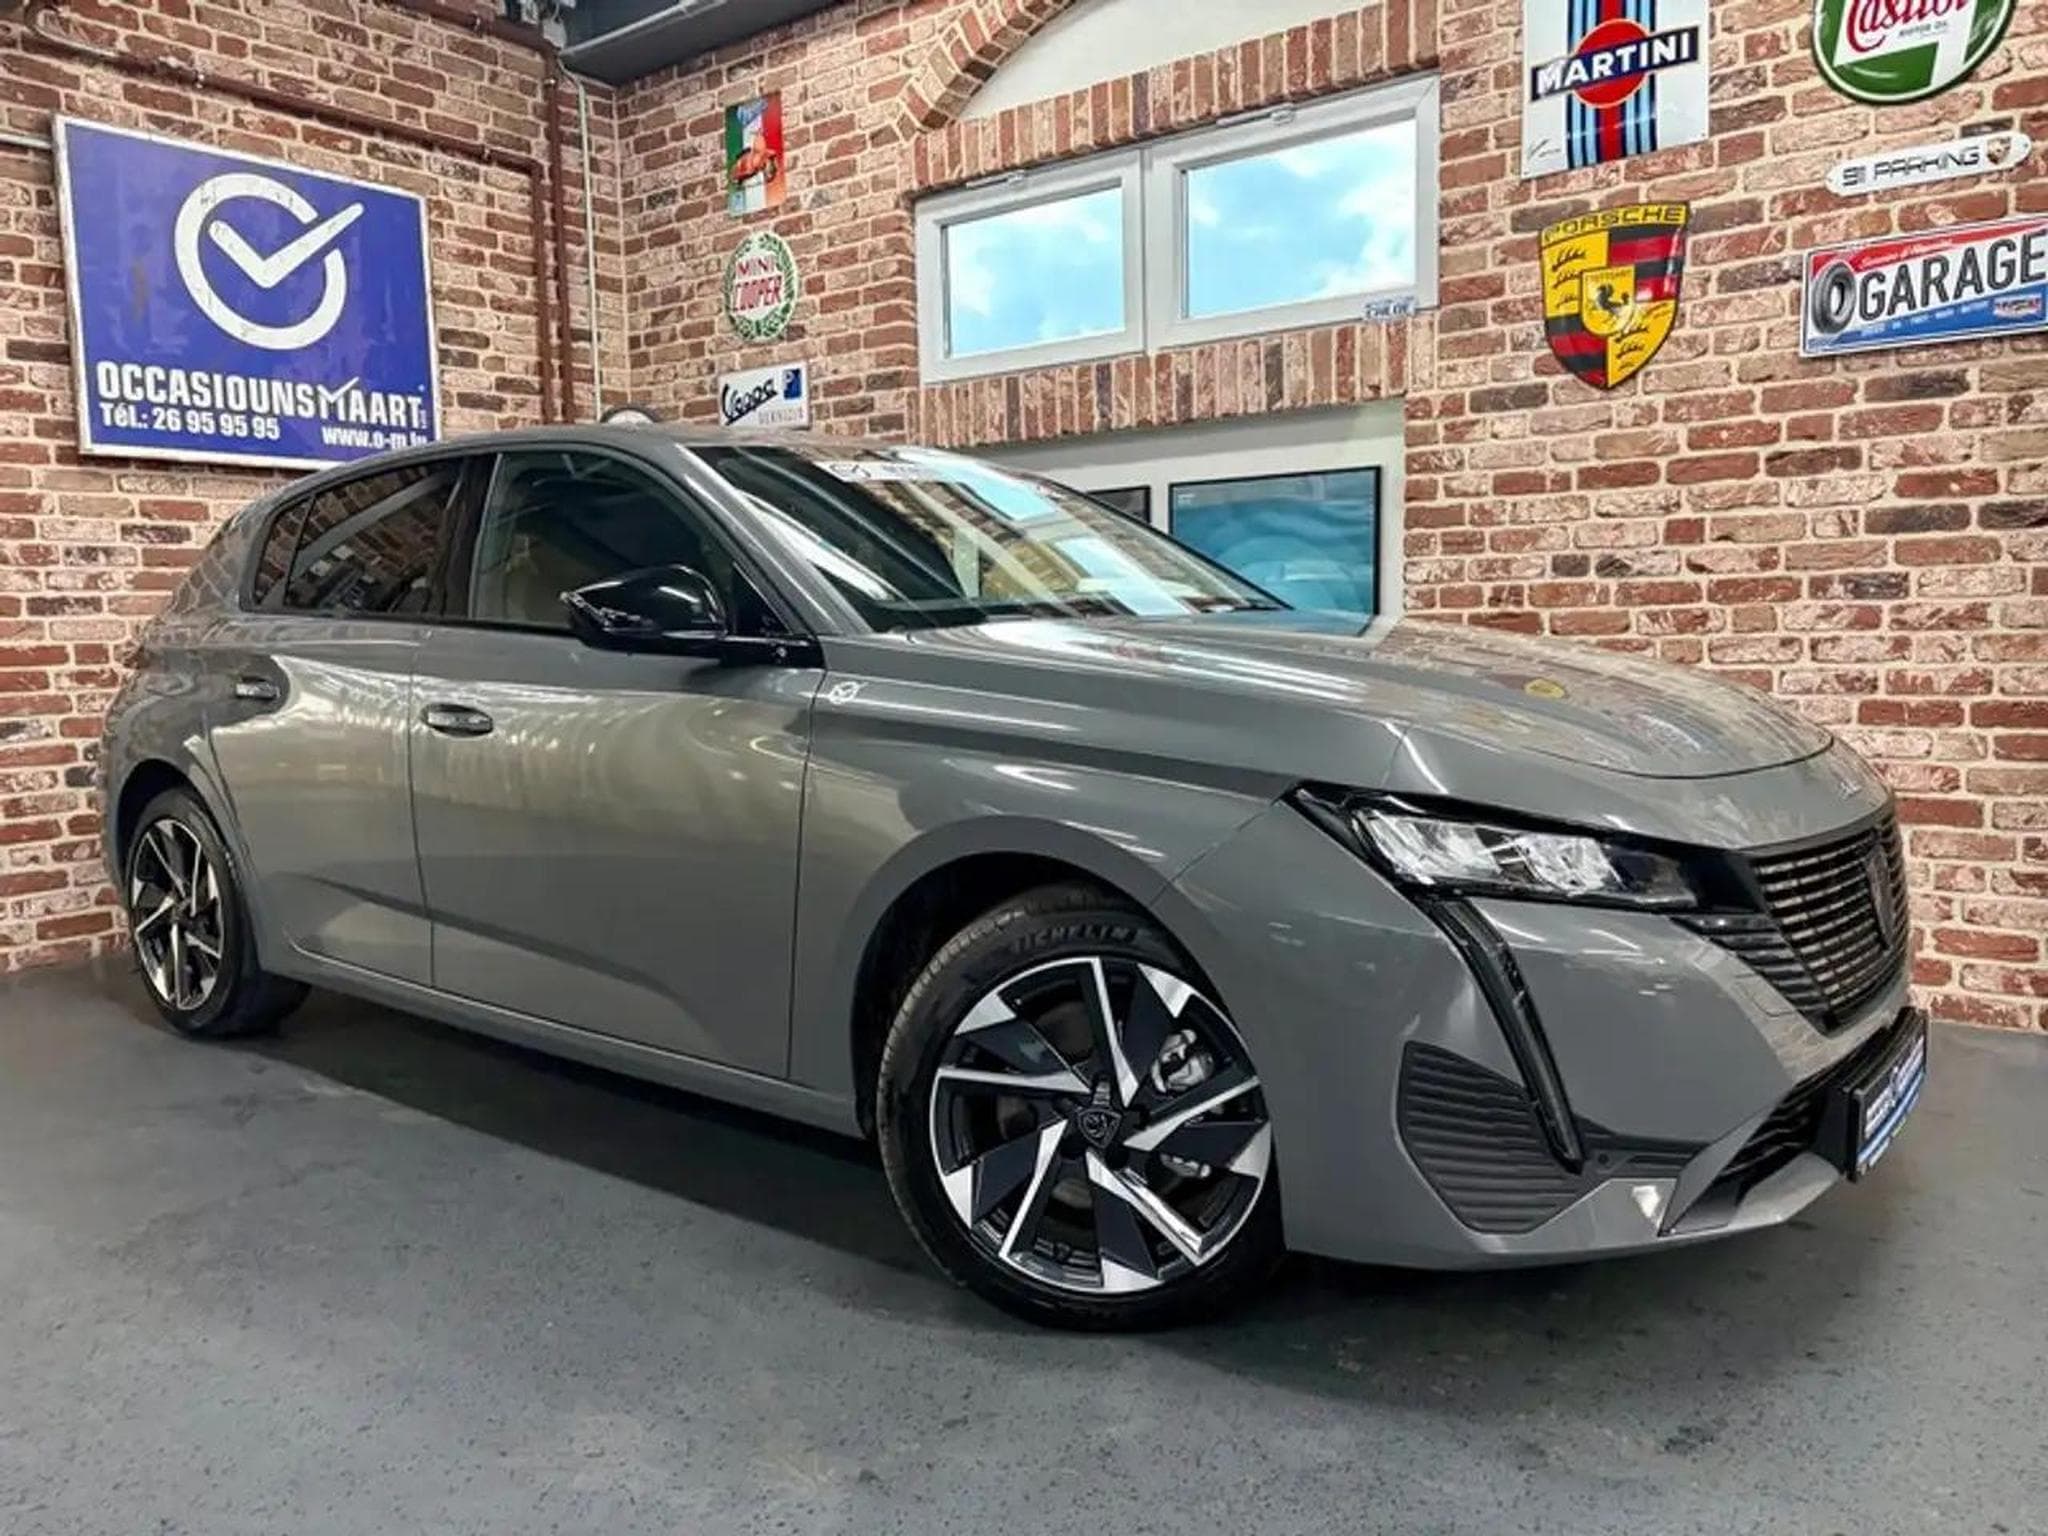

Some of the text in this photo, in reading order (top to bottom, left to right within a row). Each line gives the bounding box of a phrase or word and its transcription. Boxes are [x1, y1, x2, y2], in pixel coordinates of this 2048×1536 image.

[1846, 0, 1968, 52] Casro
[1536, 32, 1690, 96] MARTINI
[1873, 145, 1980, 180] PARKING
[1544, 203, 1682, 243] PORSCHE
[736, 253, 777, 277] MINI
[1857, 228, 2047, 321] GARAGE
[733, 275, 782, 312] COOPER
[721, 378, 778, 426] Vespa
[150, 406, 182, 433] 26
[186, 410, 217, 436] 95
[219, 412, 249, 438] 95
[251, 415, 281, 441] 95
